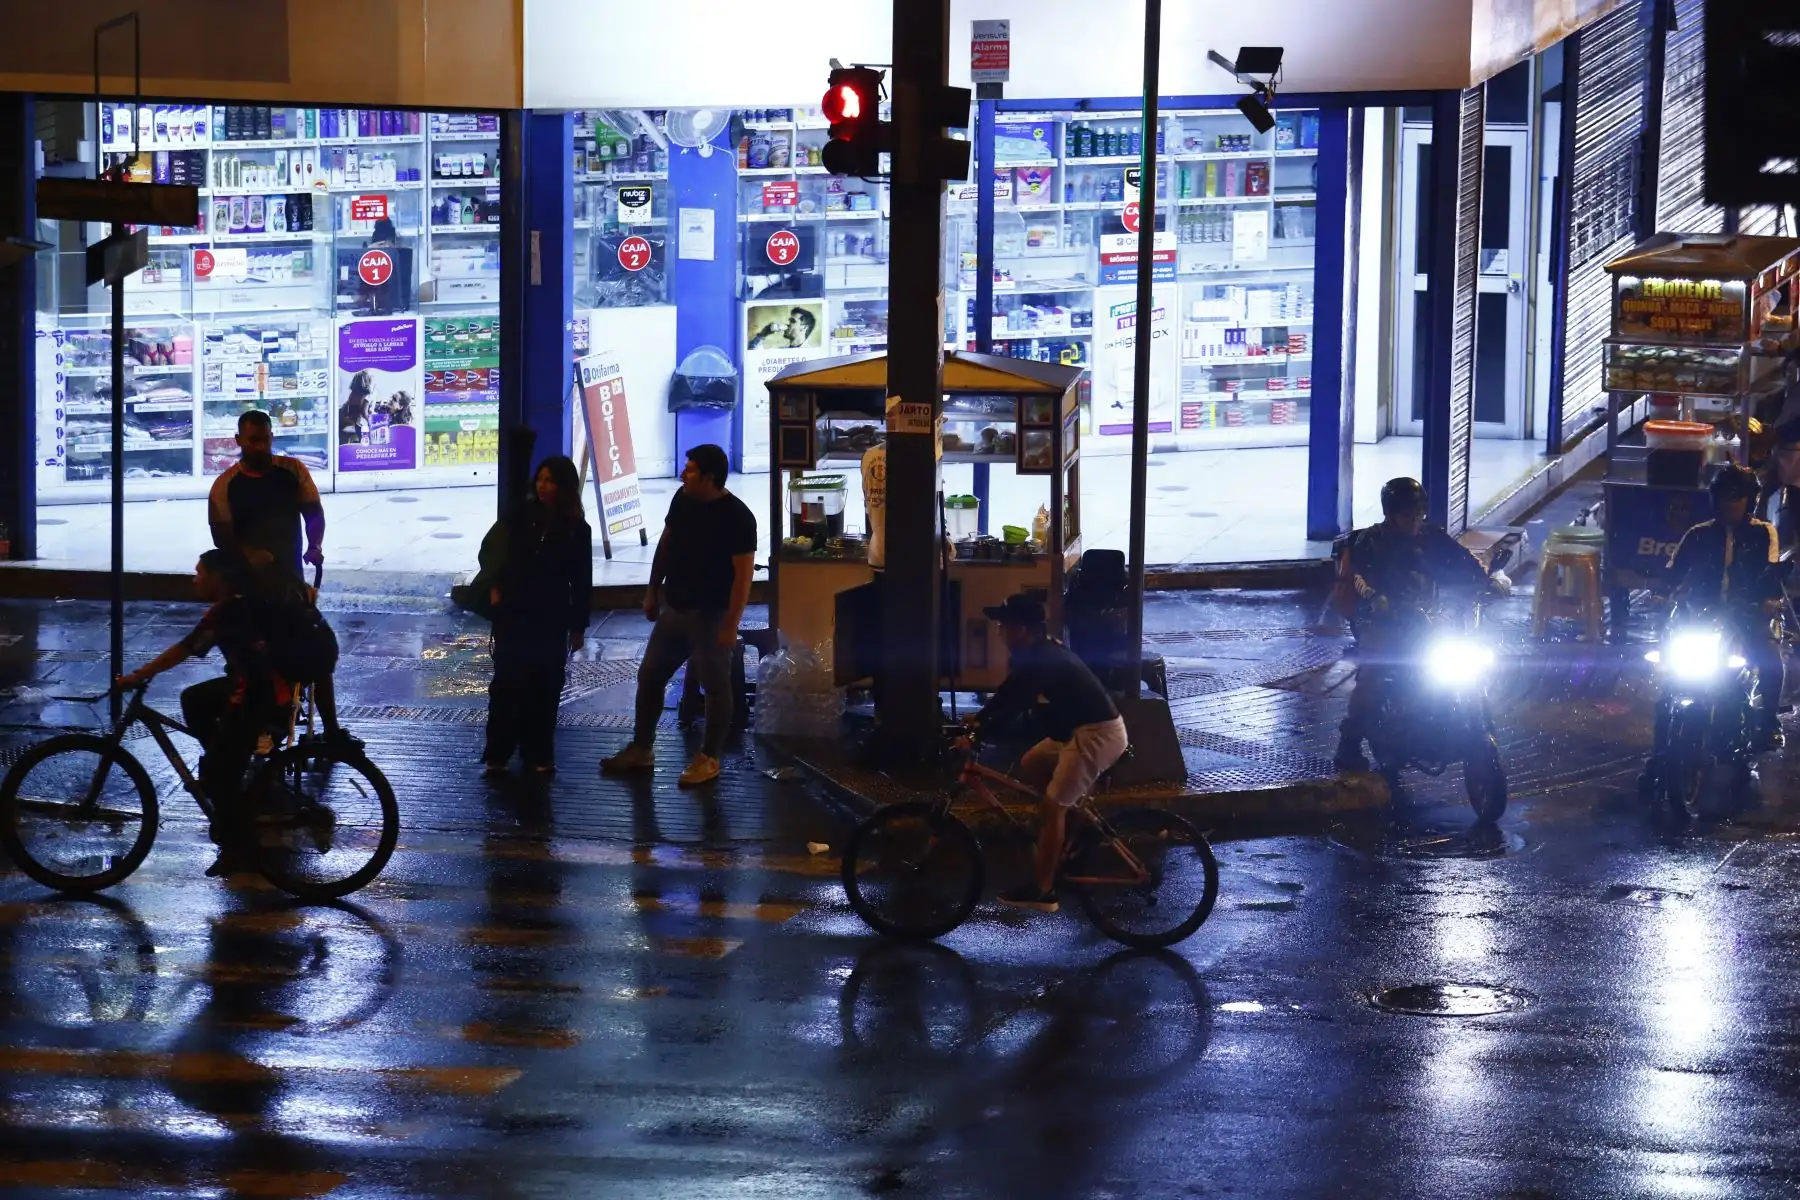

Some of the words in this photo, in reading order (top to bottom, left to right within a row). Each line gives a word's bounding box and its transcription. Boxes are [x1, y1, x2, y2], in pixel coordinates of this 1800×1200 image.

[974, 43, 1008, 51] Alarma
[622, 244, 647, 253] CAJA
[771, 238, 795, 247] CAJA
[630, 254, 639, 266] 2
[778, 249, 787, 260] 3
[362, 257, 388, 267] CAJA
[371, 268, 380, 280] 1
[1643, 280, 1722, 299] EMOLIENTE
[1669, 302, 1700, 314] MACA
[592, 363, 620, 380] Otifarma
[599, 385, 624, 477] BOTICA
